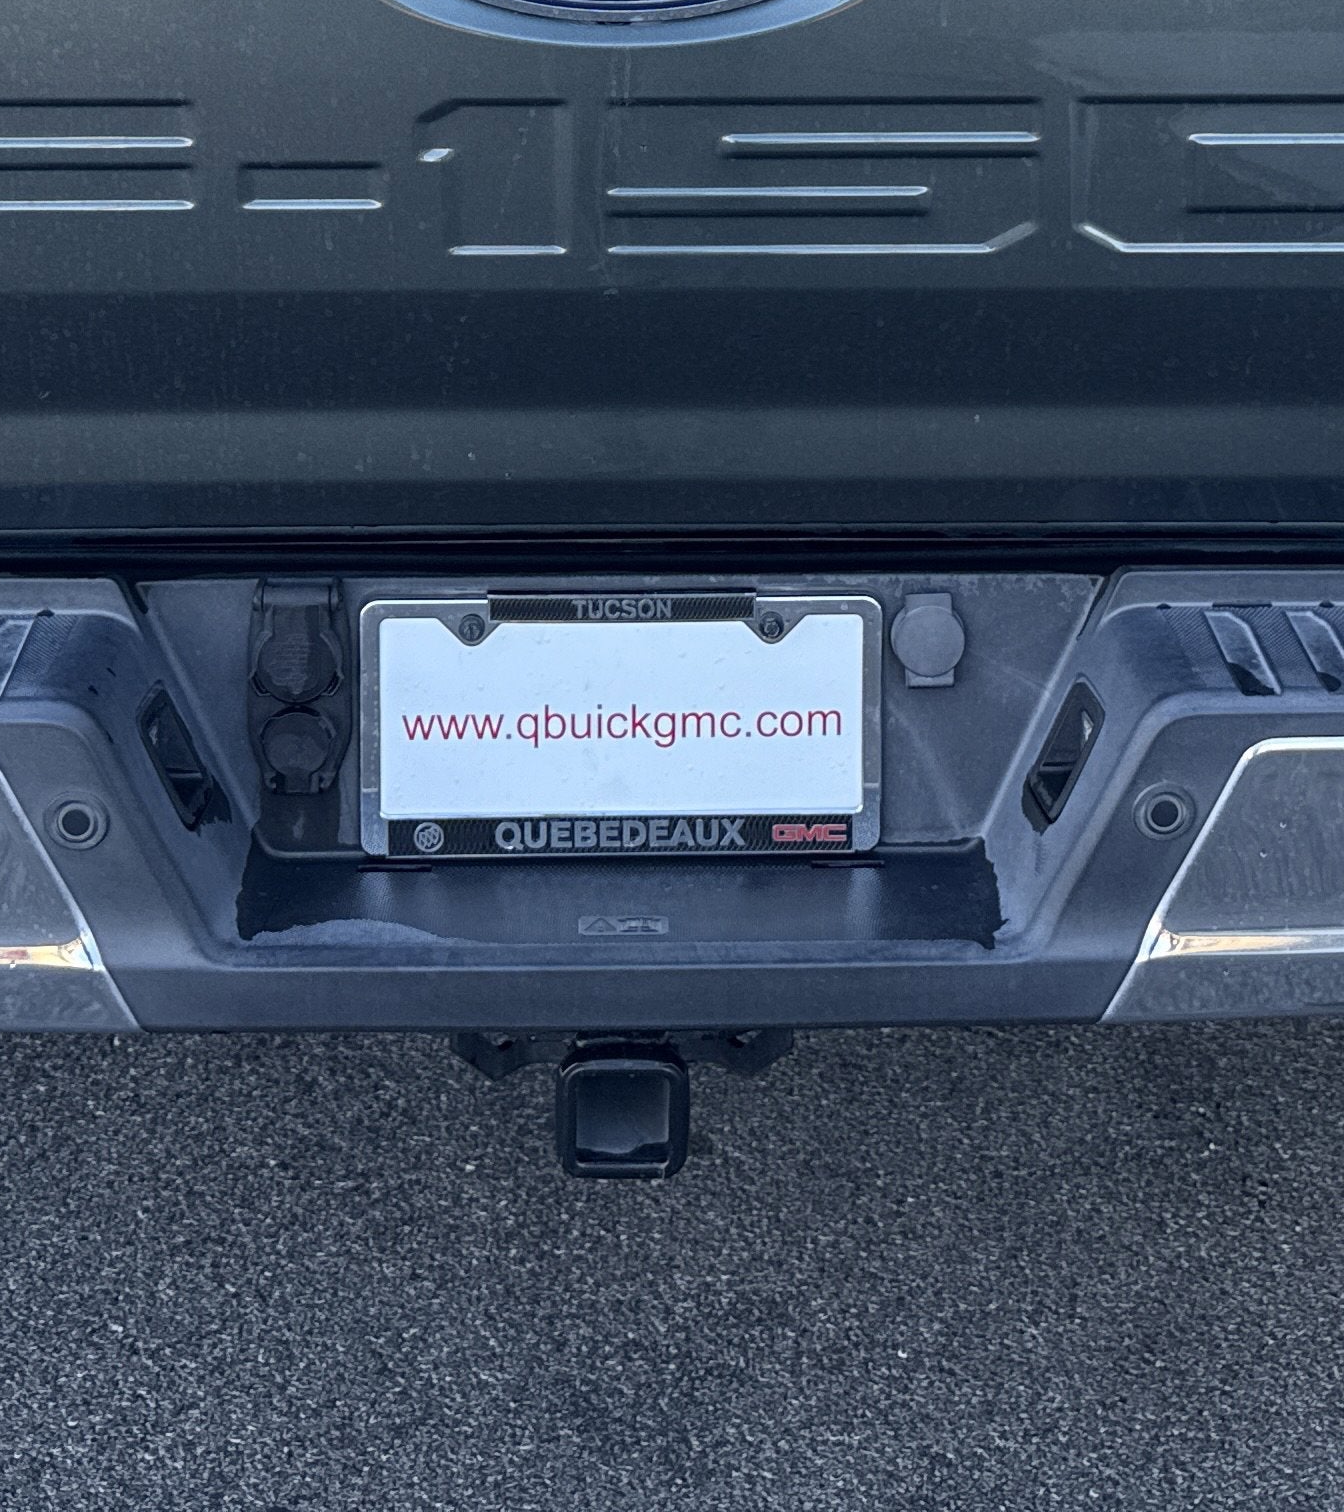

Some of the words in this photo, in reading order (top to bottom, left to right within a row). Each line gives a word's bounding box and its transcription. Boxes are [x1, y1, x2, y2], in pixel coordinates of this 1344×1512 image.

[571, 598, 672, 619] TUCSON
[402, 703, 843, 748] www.qbuickgmc.com
[494, 818, 746, 851] QUEBEDEAUX
[771, 823, 848, 842] GMC
